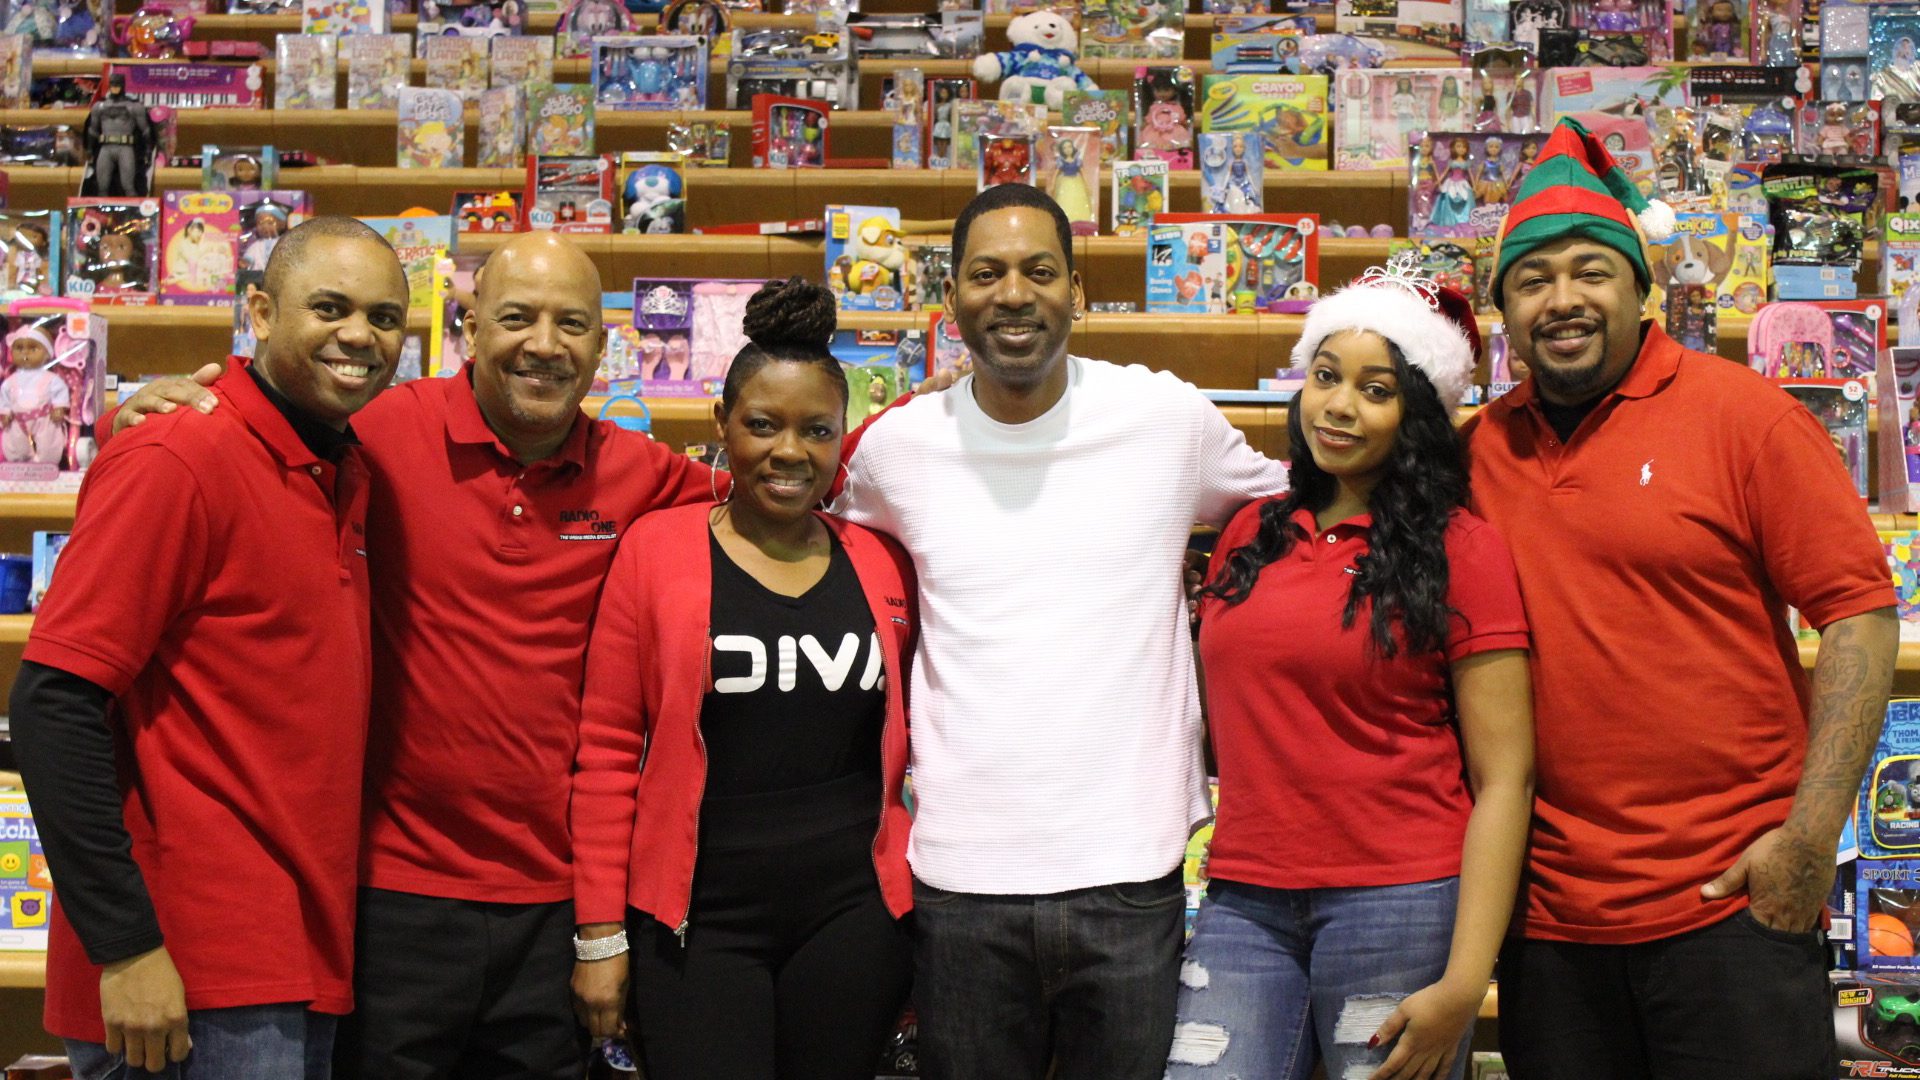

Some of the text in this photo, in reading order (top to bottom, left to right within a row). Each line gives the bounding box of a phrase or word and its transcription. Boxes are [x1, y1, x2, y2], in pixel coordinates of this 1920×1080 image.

[1252, 82, 1304, 93] CRAYON
[1116, 164, 1167, 177] TROUBLE
[1673, 217, 1716, 235] TCHKINS
[68, 282, 94, 294] KID
[560, 510, 599, 522] RADIO
[591, 521, 616, 532] ONE
[1893, 729, 1920, 738] THOM
[1862, 868, 1910, 881] SPORT
